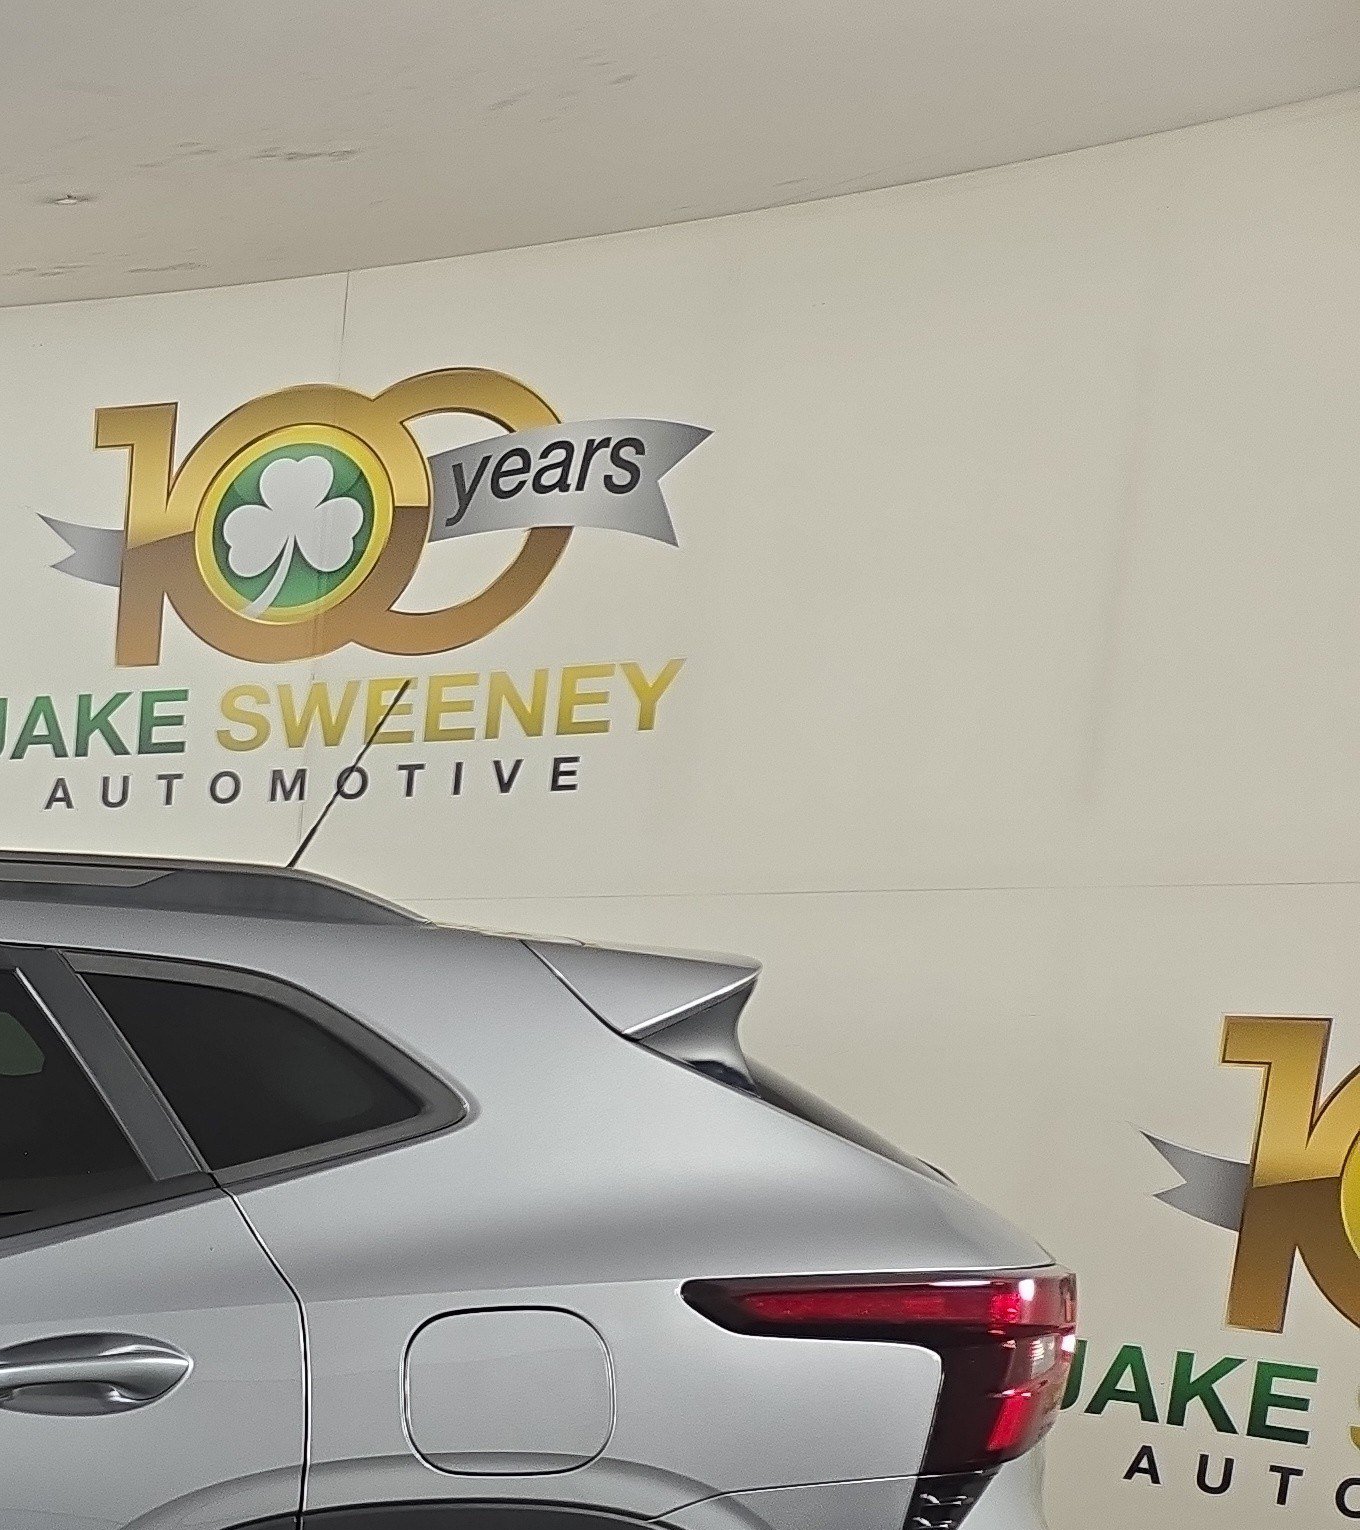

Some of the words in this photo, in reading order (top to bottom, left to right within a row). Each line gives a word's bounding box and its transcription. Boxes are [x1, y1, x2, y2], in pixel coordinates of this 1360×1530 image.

[94, 366, 574, 667] 100
[446, 434, 647, 526] years
[215, 658, 686, 752] SWEENEY
[44, 755, 580, 810] AUTOMOTIVE
